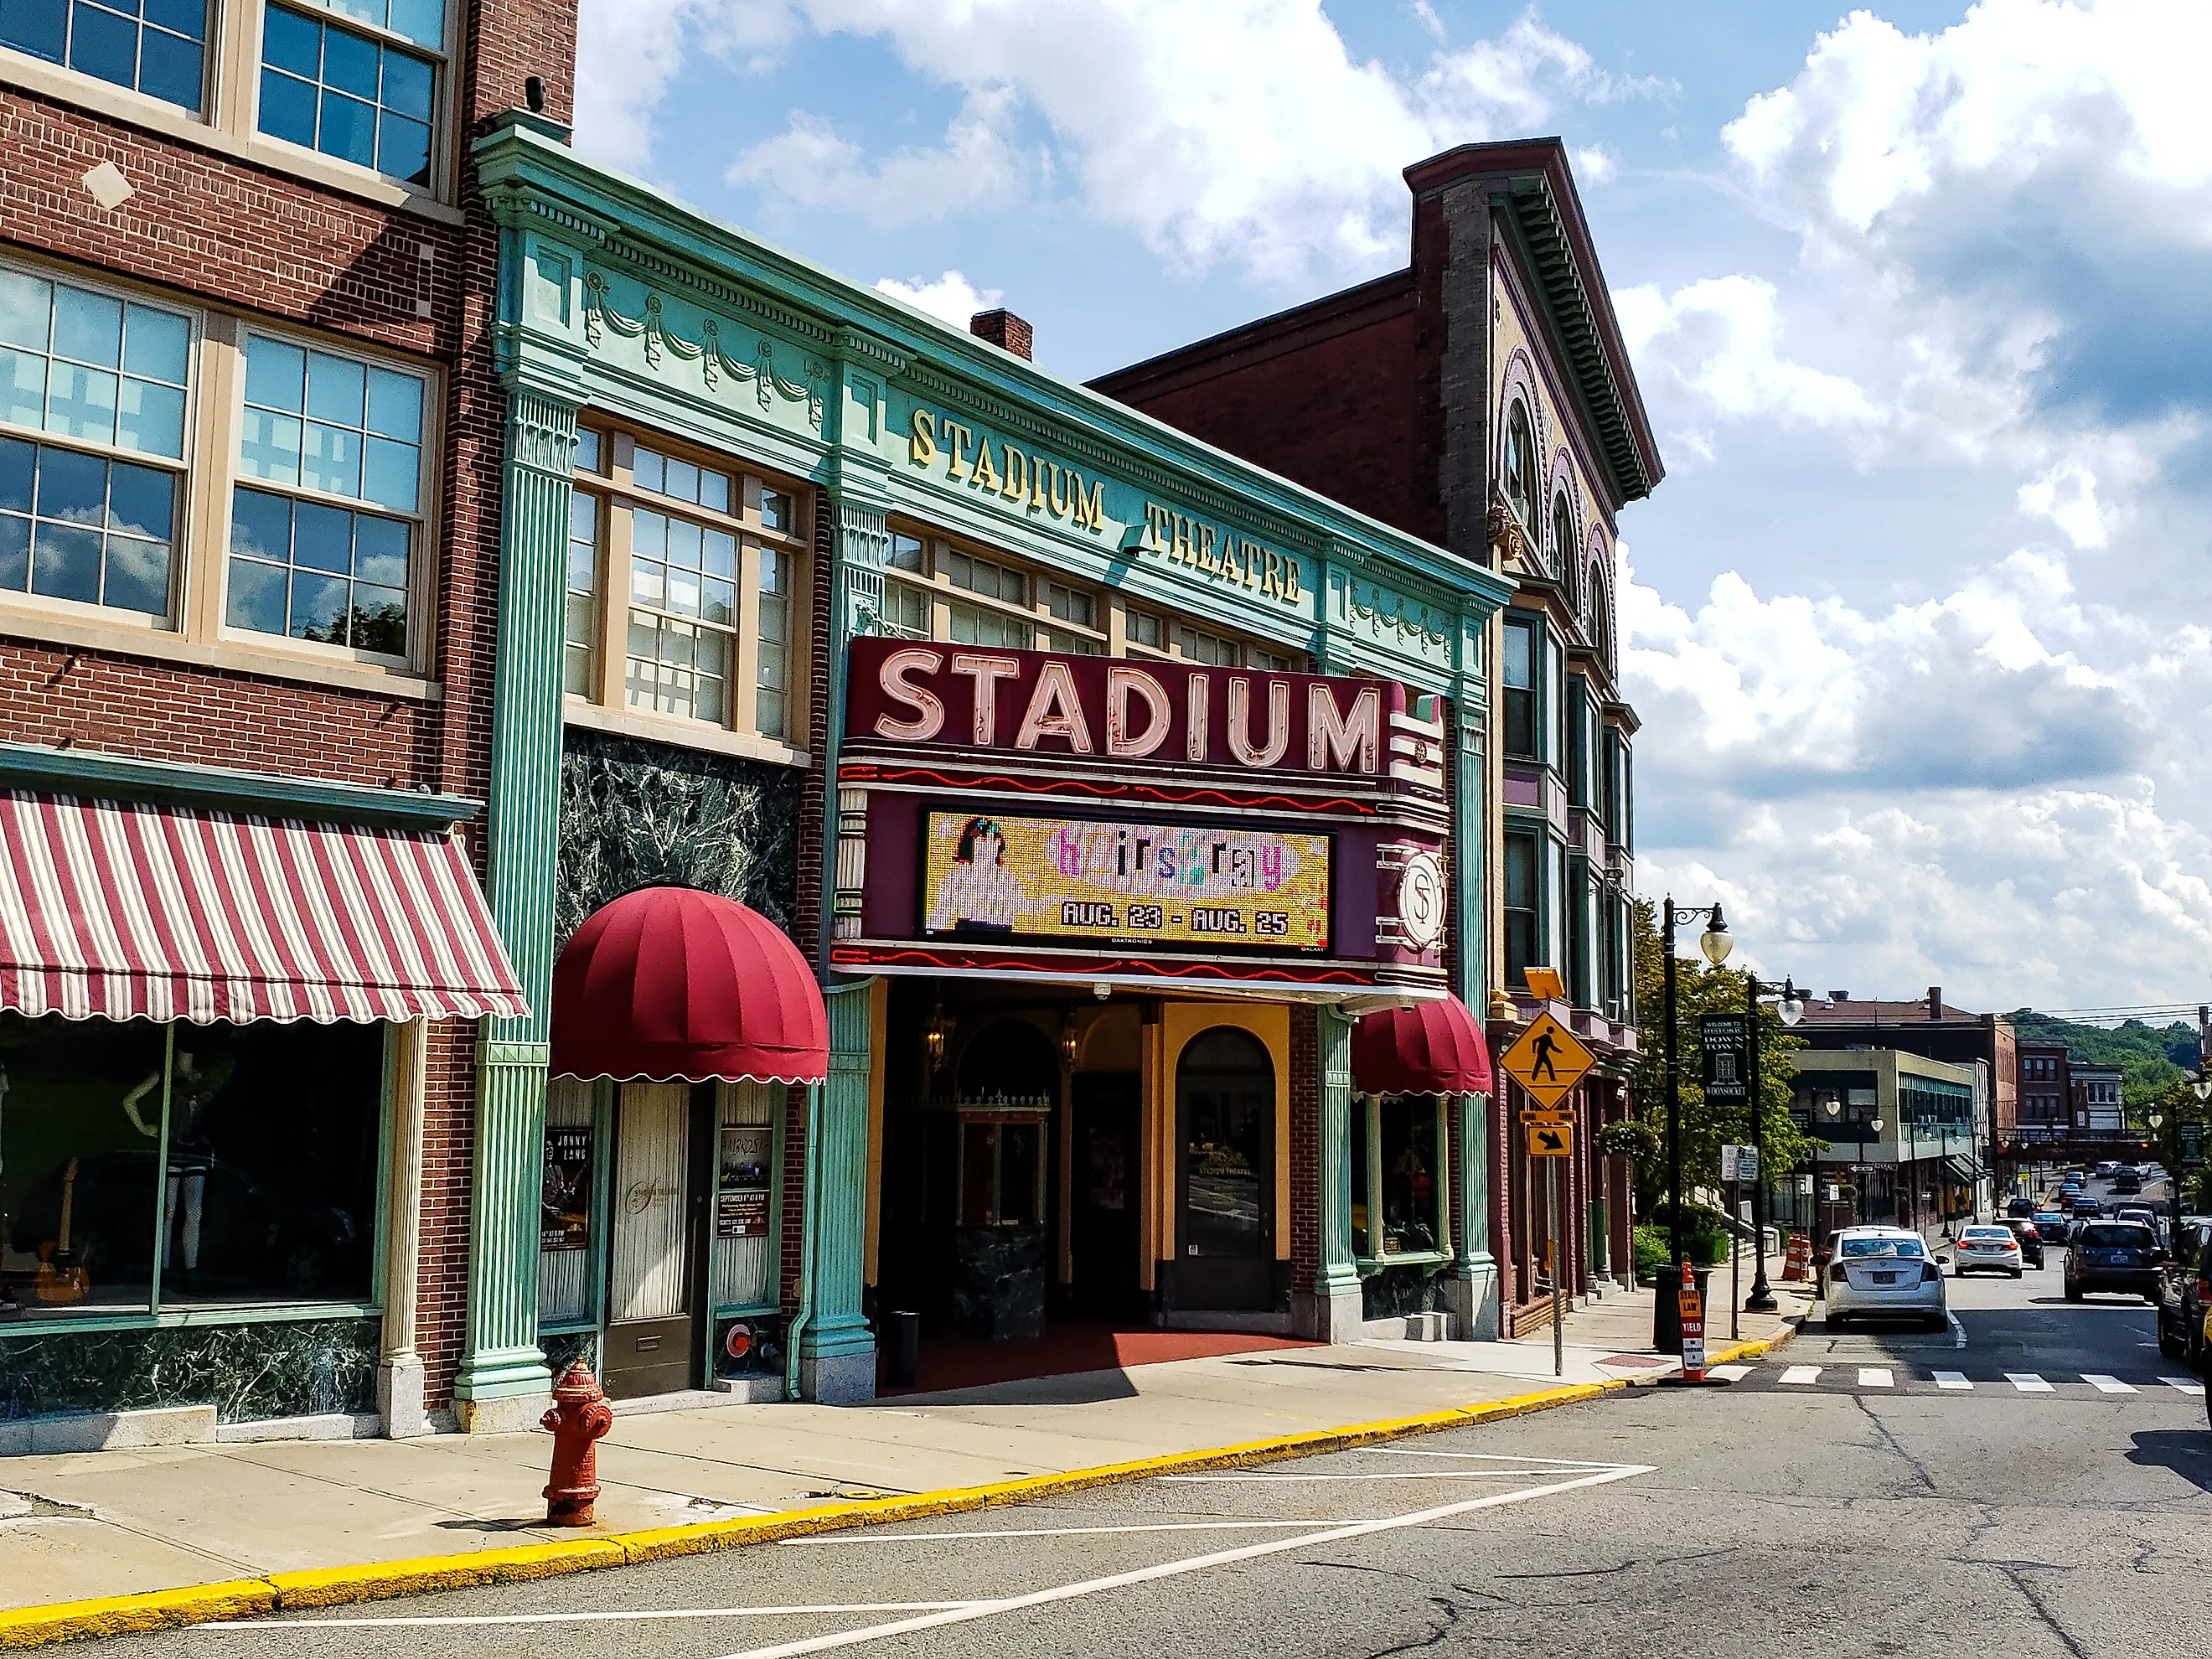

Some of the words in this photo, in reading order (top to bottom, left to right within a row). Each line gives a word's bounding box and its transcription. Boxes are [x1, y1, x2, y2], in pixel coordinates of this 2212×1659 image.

[912, 409, 1105, 533] STADIUM
[1146, 502, 1300, 605] THEATRE
[874, 648, 1381, 775] STADIUM
[1062, 902, 1119, 928] AUG.
[1129, 905, 1162, 930] 23
[1191, 907, 1247, 934] AUG.
[1255, 911, 1289, 935] 25
[1706, 1086, 1746, 1096] WOONSOCKET
[557, 1135, 587, 1146] JONNY
[563, 1149, 587, 1160] LANG
[1679, 1290, 1700, 1300] STATE
[1682, 1302, 1697, 1312] LAW
[1682, 1323, 1702, 1332] YIELD
